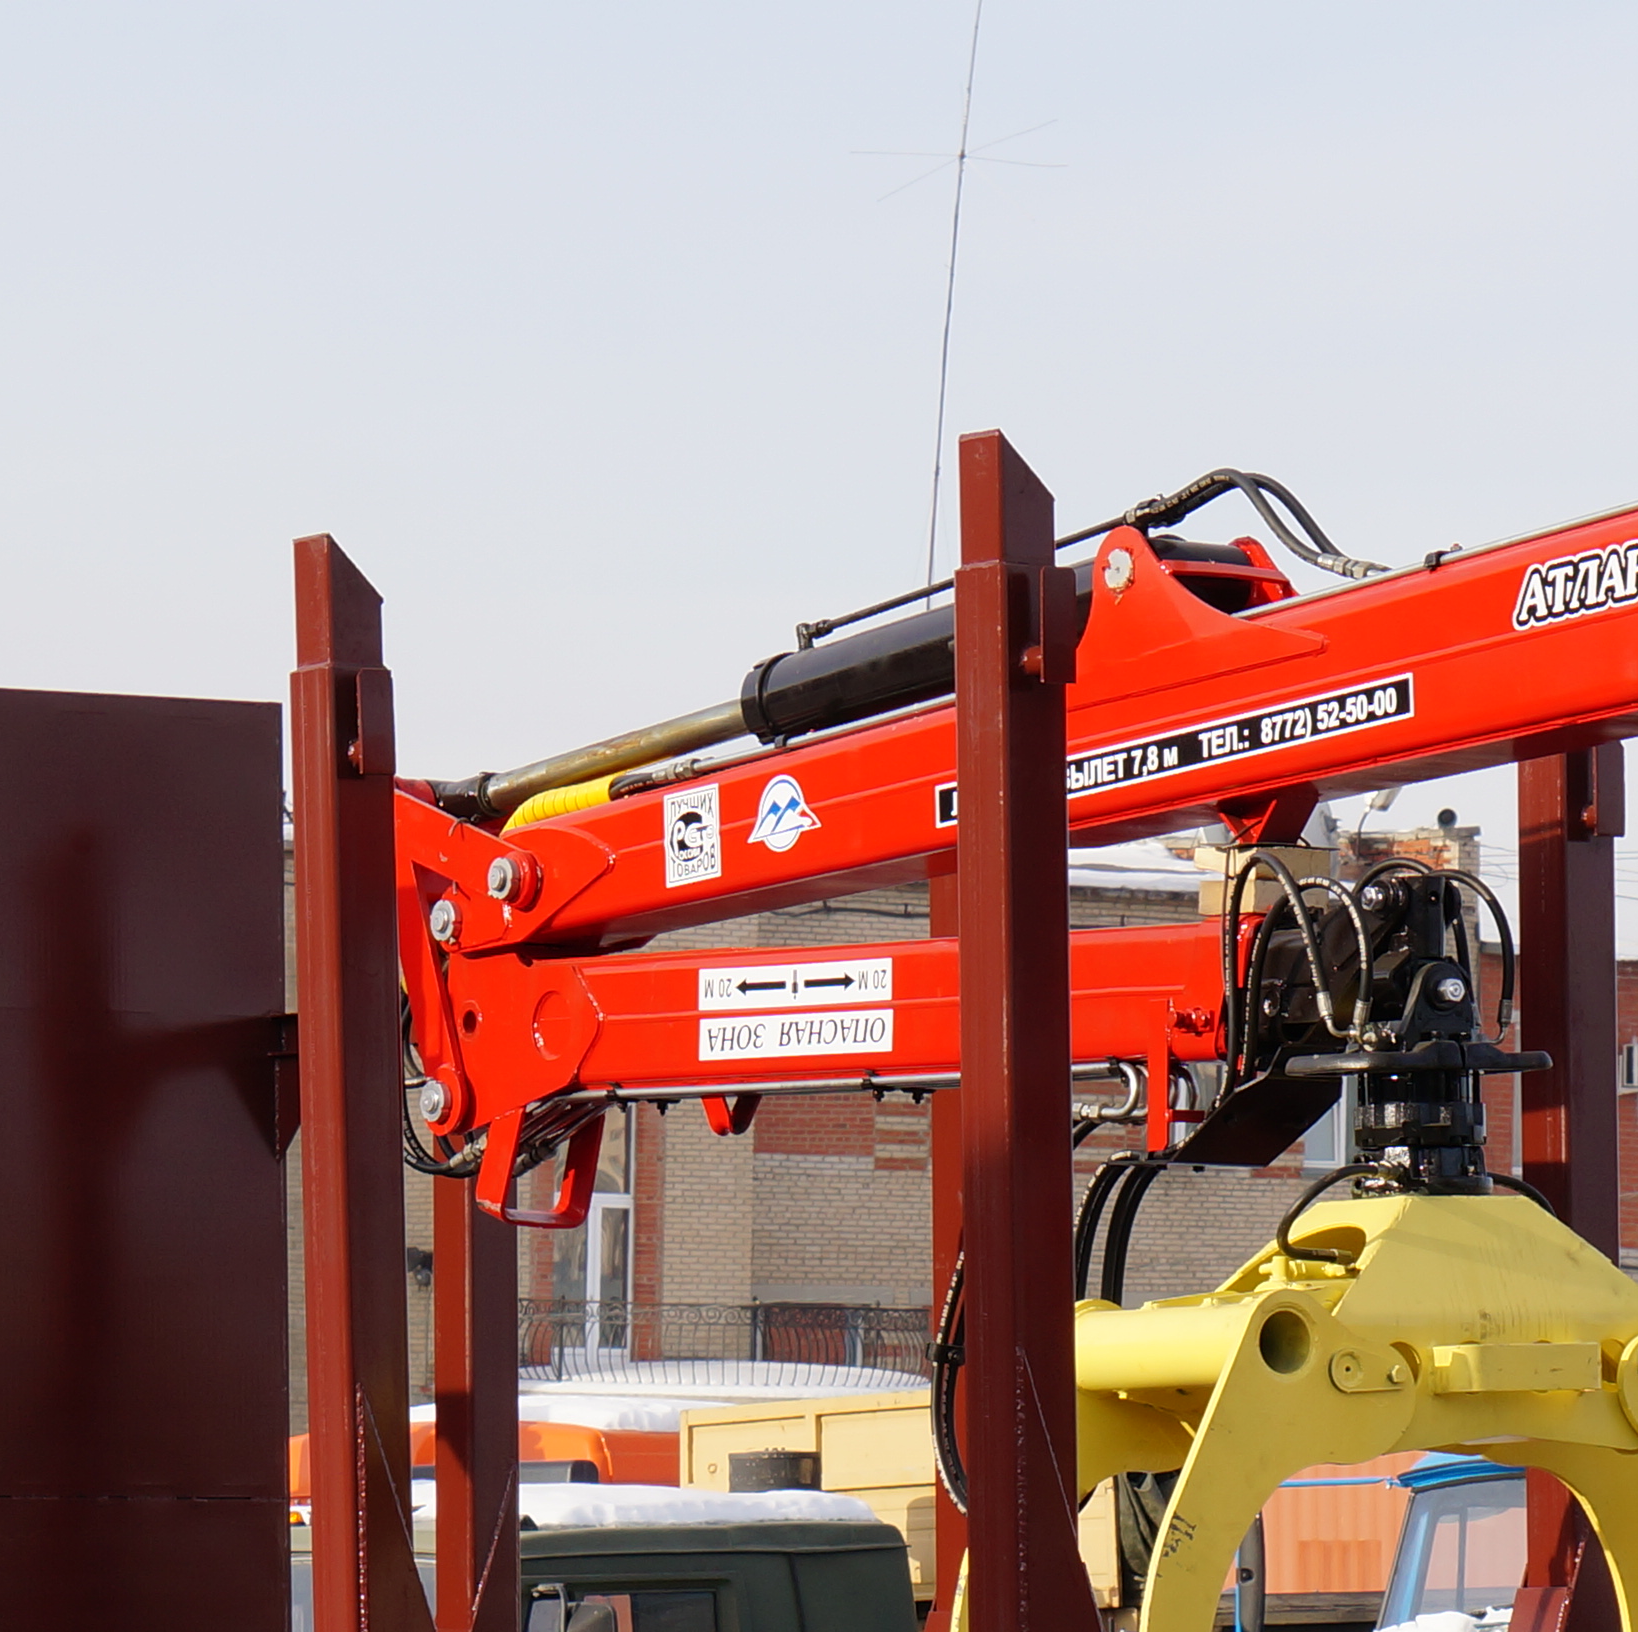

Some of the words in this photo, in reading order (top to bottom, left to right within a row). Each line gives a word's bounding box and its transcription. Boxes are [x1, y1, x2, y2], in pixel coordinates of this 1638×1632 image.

[1130, 745, 1159, 777] 7,8
[1198, 725, 1250, 758] ТЕЛ.:
[1260, 707, 1313, 744] 8772)
[1316, 686, 1397, 730] 52-50-00
[670, 792, 715, 825] ЛУЧШИХ
[671, 843, 716, 879] ТОВАРОВ
[707, 1023, 766, 1053] ЗОНА
[778, 1017, 886, 1047] ОПАСНАЯ
